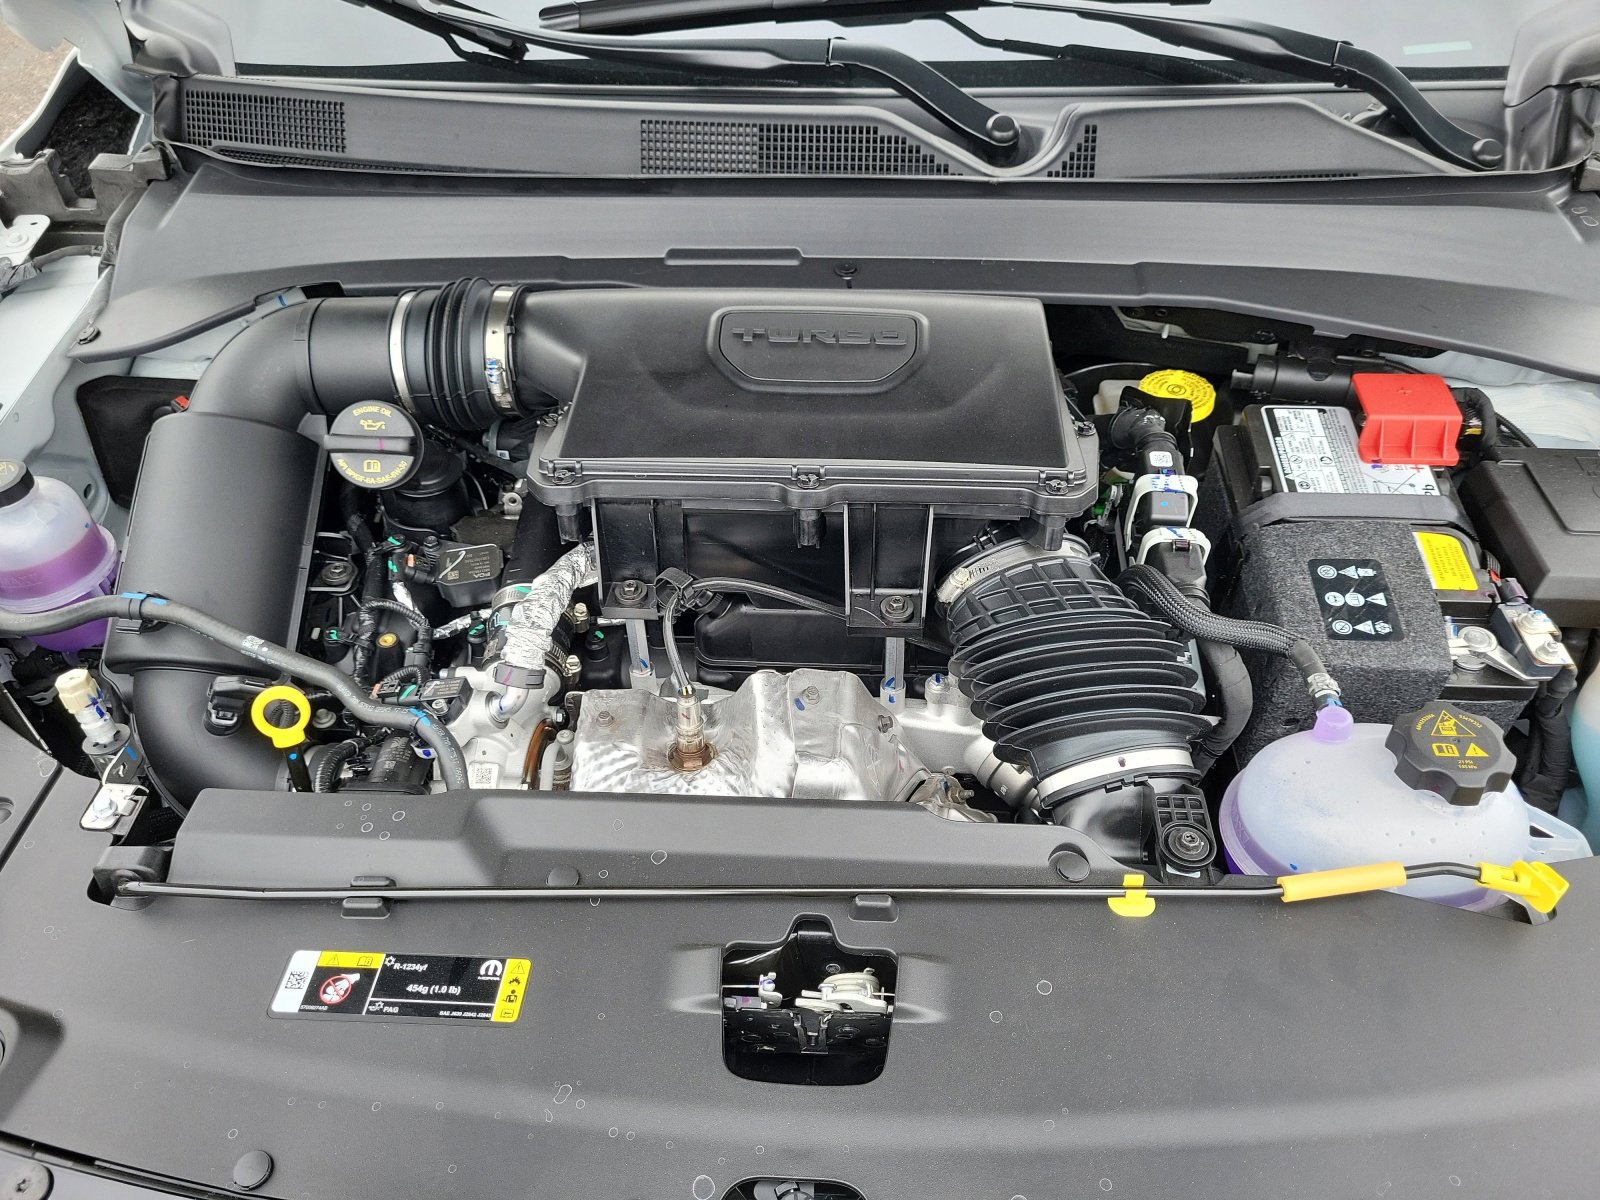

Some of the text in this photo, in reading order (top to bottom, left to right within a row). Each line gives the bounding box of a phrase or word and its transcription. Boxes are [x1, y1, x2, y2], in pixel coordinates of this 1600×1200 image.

[732, 328, 907, 345] TURBO
[352, 405, 392, 418] ENGINE OIL
[393, 962, 429, 972] R-1234yf
[406, 984, 461, 996] 454g (1.0 lb)
[382, 1006, 400, 1014] PAG
